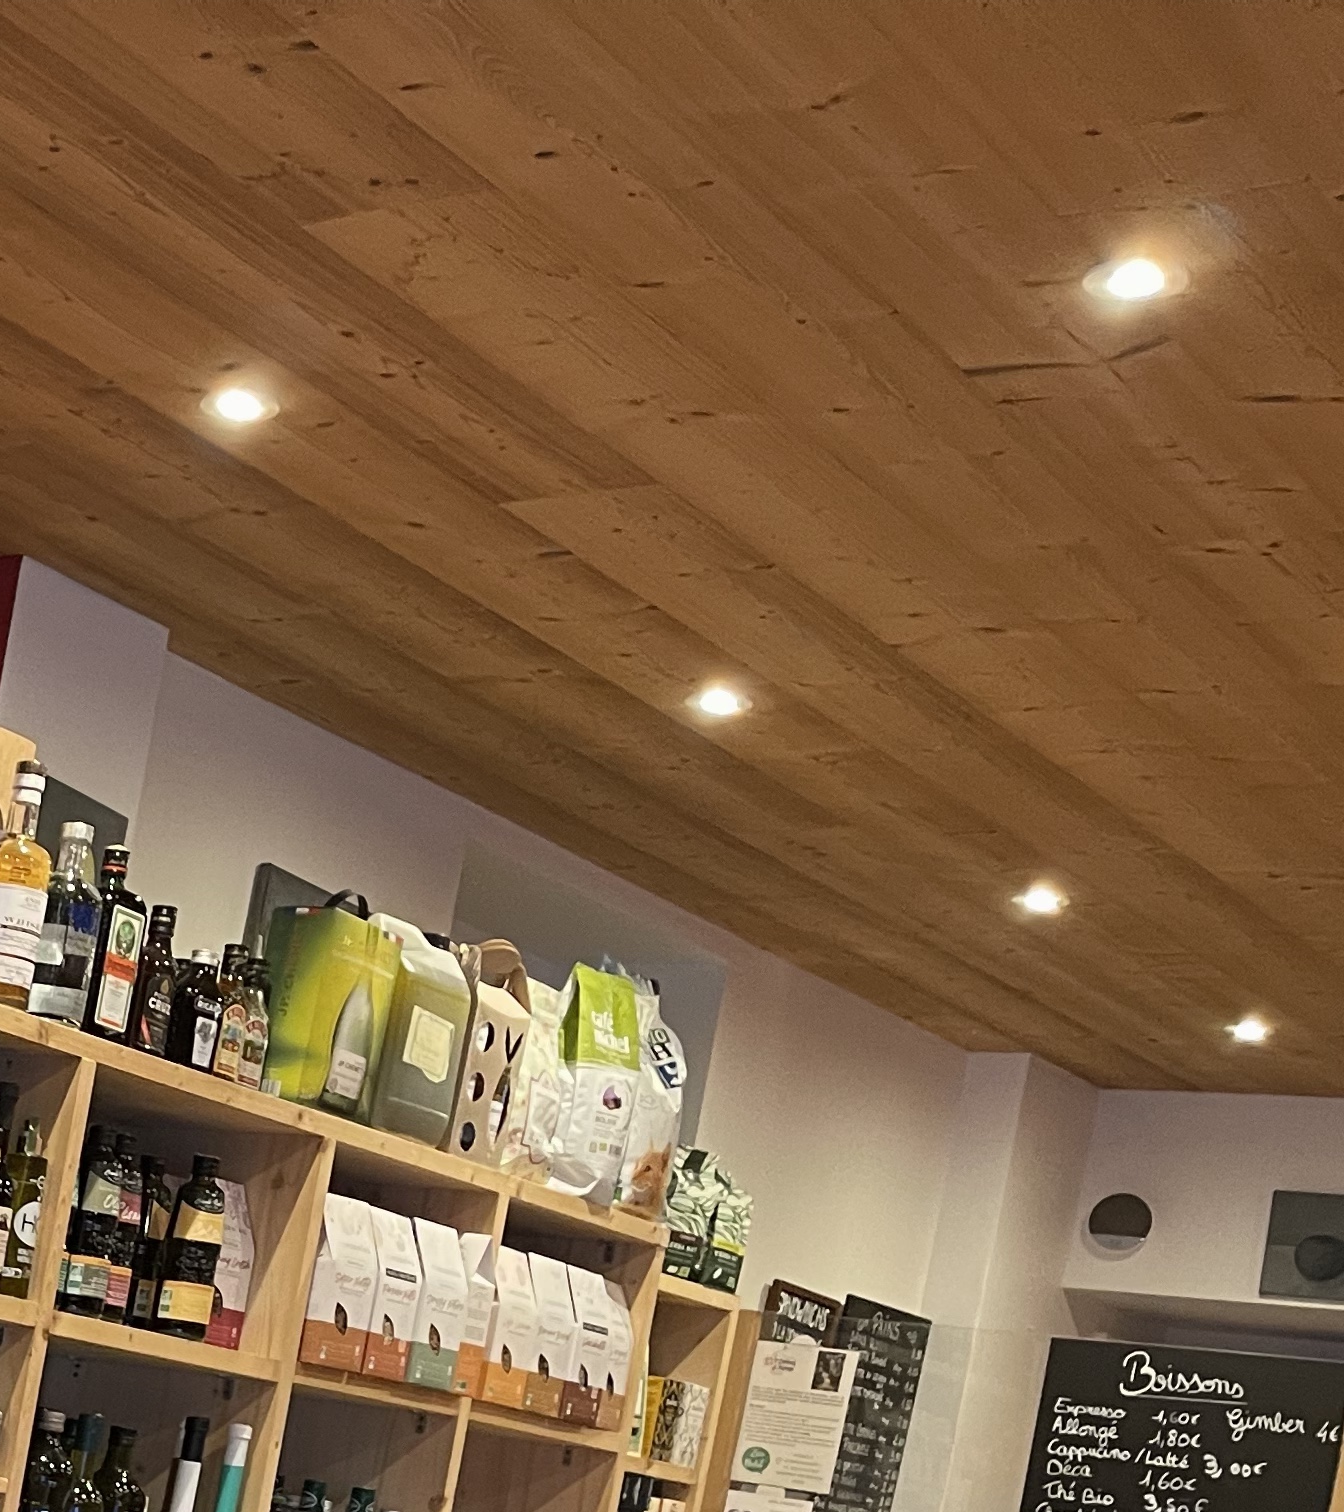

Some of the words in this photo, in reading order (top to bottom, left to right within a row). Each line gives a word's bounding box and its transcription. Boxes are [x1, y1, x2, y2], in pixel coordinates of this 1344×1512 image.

[1119, 1350, 1244, 1399] Boissons
[1054, 1398, 1127, 1421] Expresso
[1226, 1408, 1306, 1442] Gimber
[1316, 1421, 1339, 1443] 4€
[1052, 1417, 1119, 1447] Allongé
[1149, 1431, 1201, 1449] 1,80€
[1047, 1438, 1131, 1462] Cappucino
[1047, 1457, 1093, 1478] Déca
[1139, 1472, 1197, 1492] 1,60€
[1042, 1481, 1076, 1503] Thé
[1082, 1488, 1114, 1506] Bio
